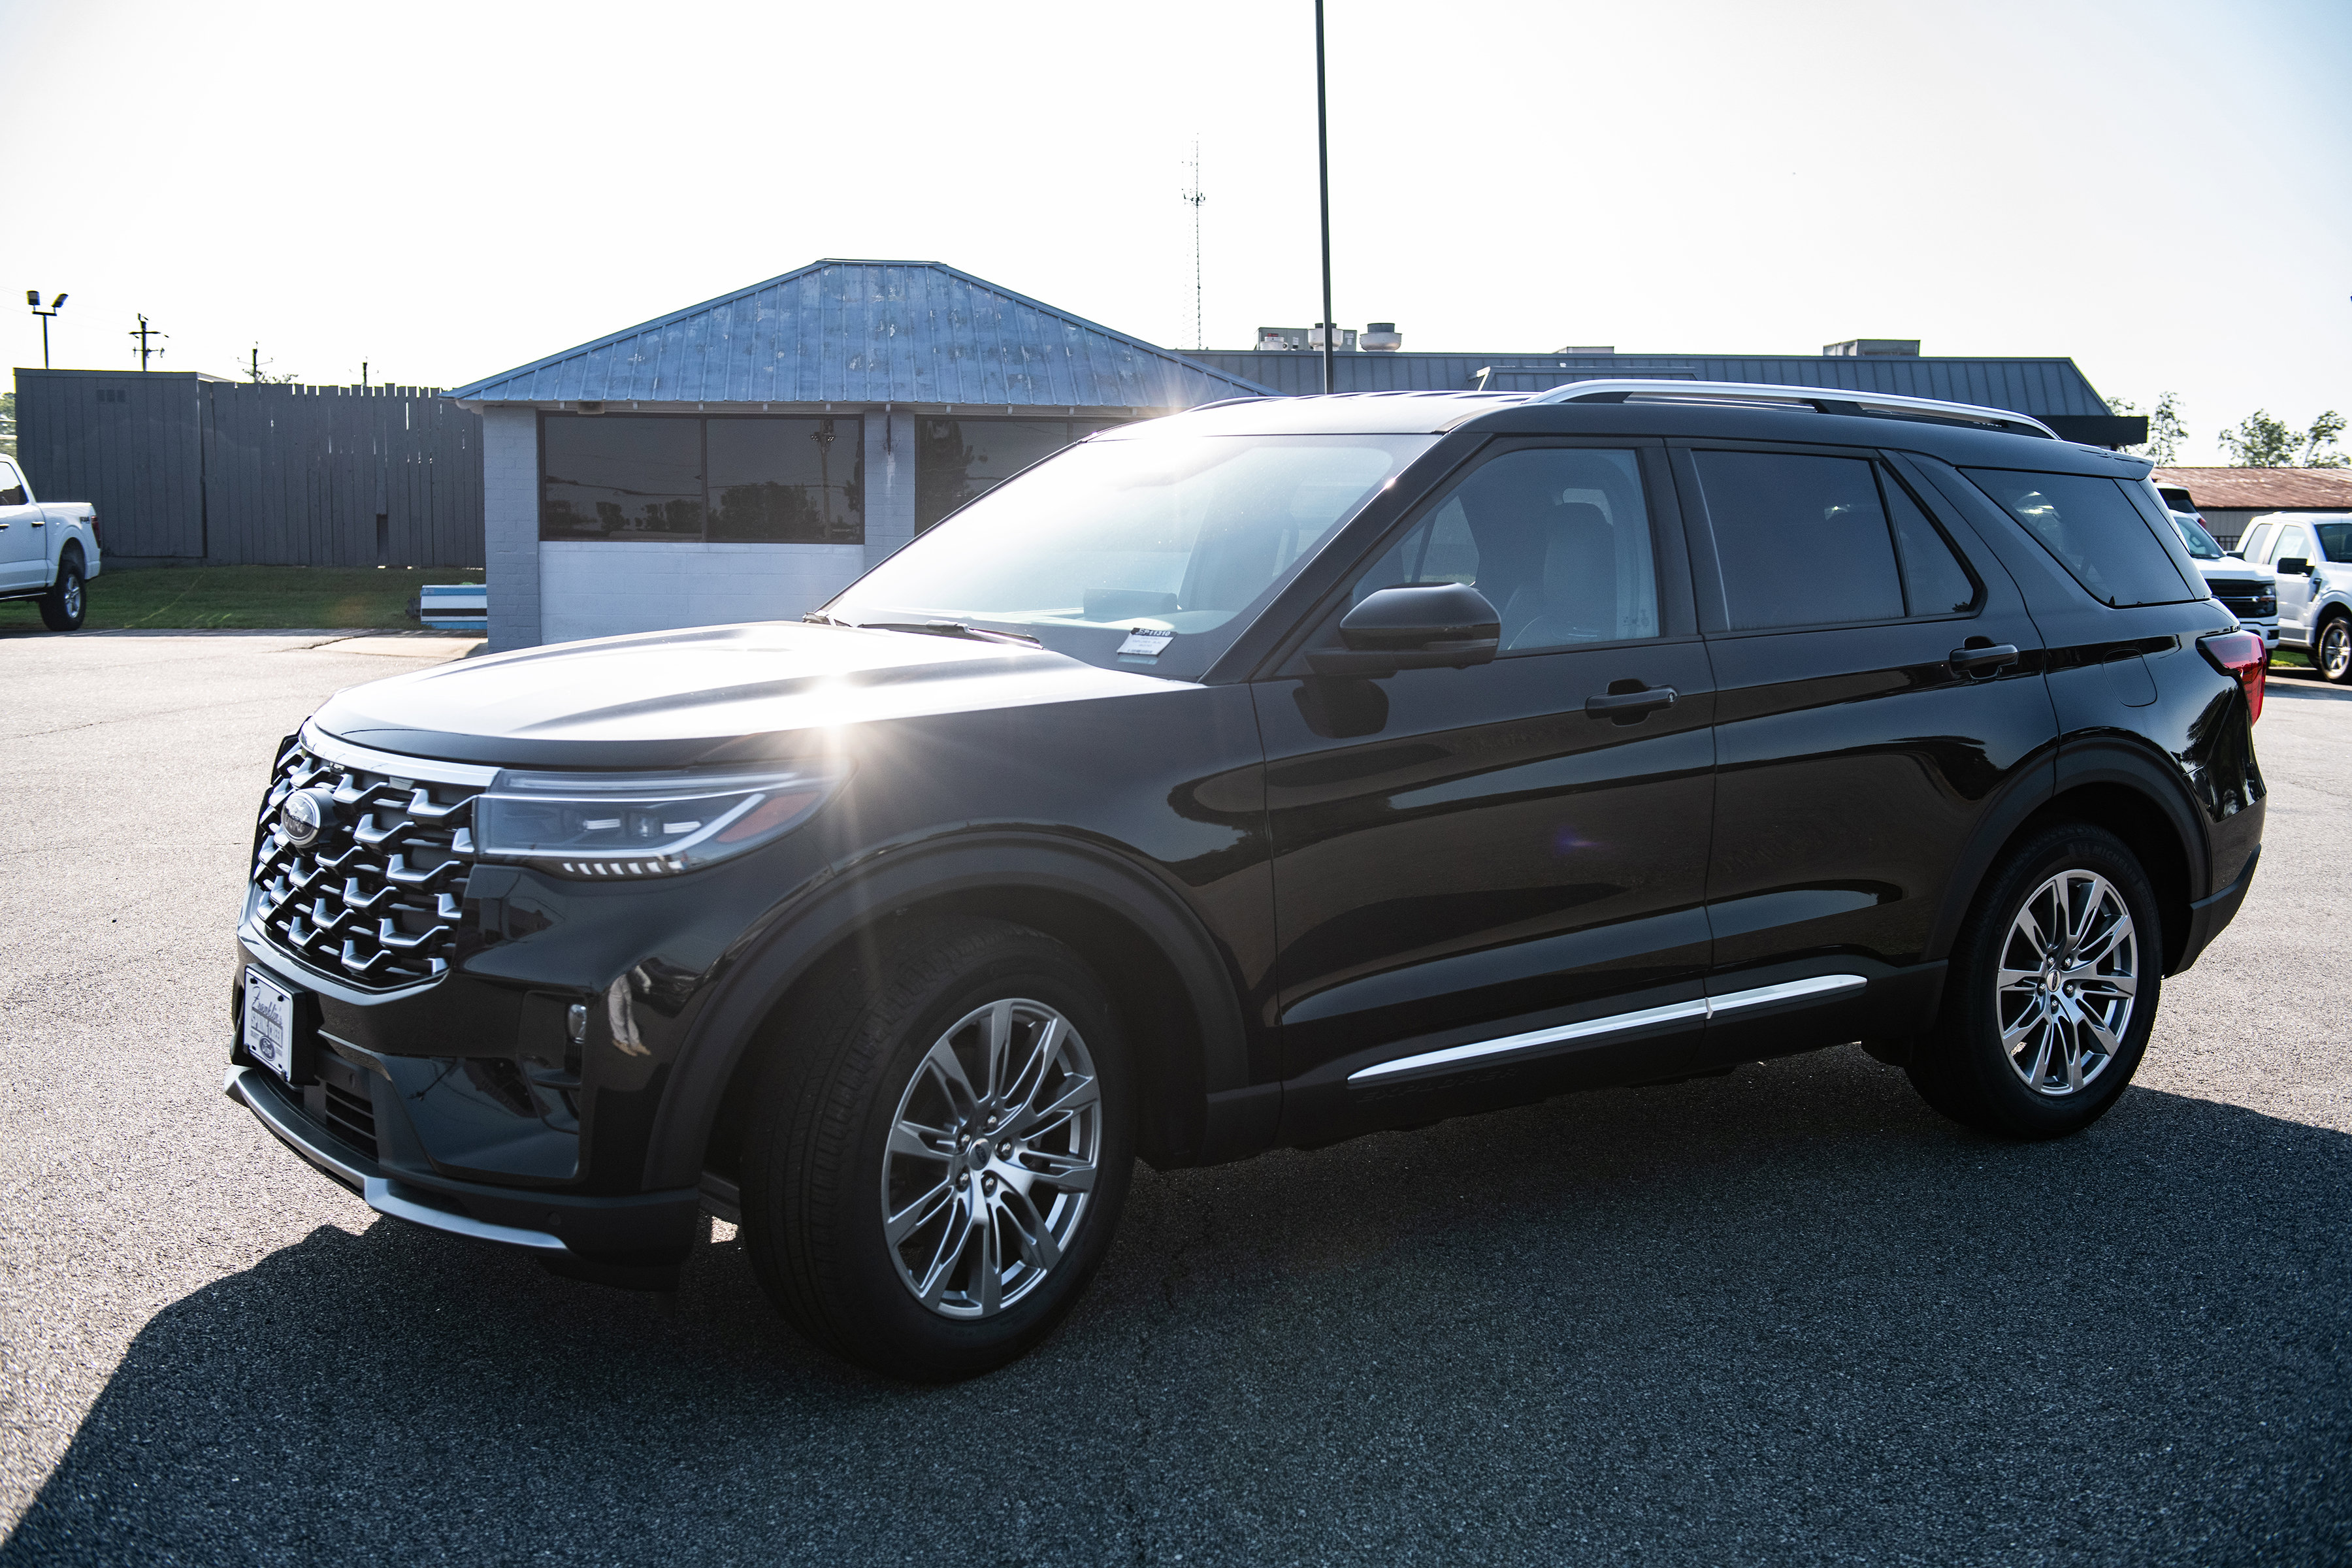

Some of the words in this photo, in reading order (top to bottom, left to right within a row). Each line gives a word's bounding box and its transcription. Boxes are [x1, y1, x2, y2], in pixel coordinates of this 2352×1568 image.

[285, 801, 308, 834] Ford
[2091, 845, 2138, 883] MICHELIN
[252, 985, 282, 1025] Franklin's
[261, 1039, 273, 1056] Ford
[1356, 1068, 1519, 1103] EXPLORER
